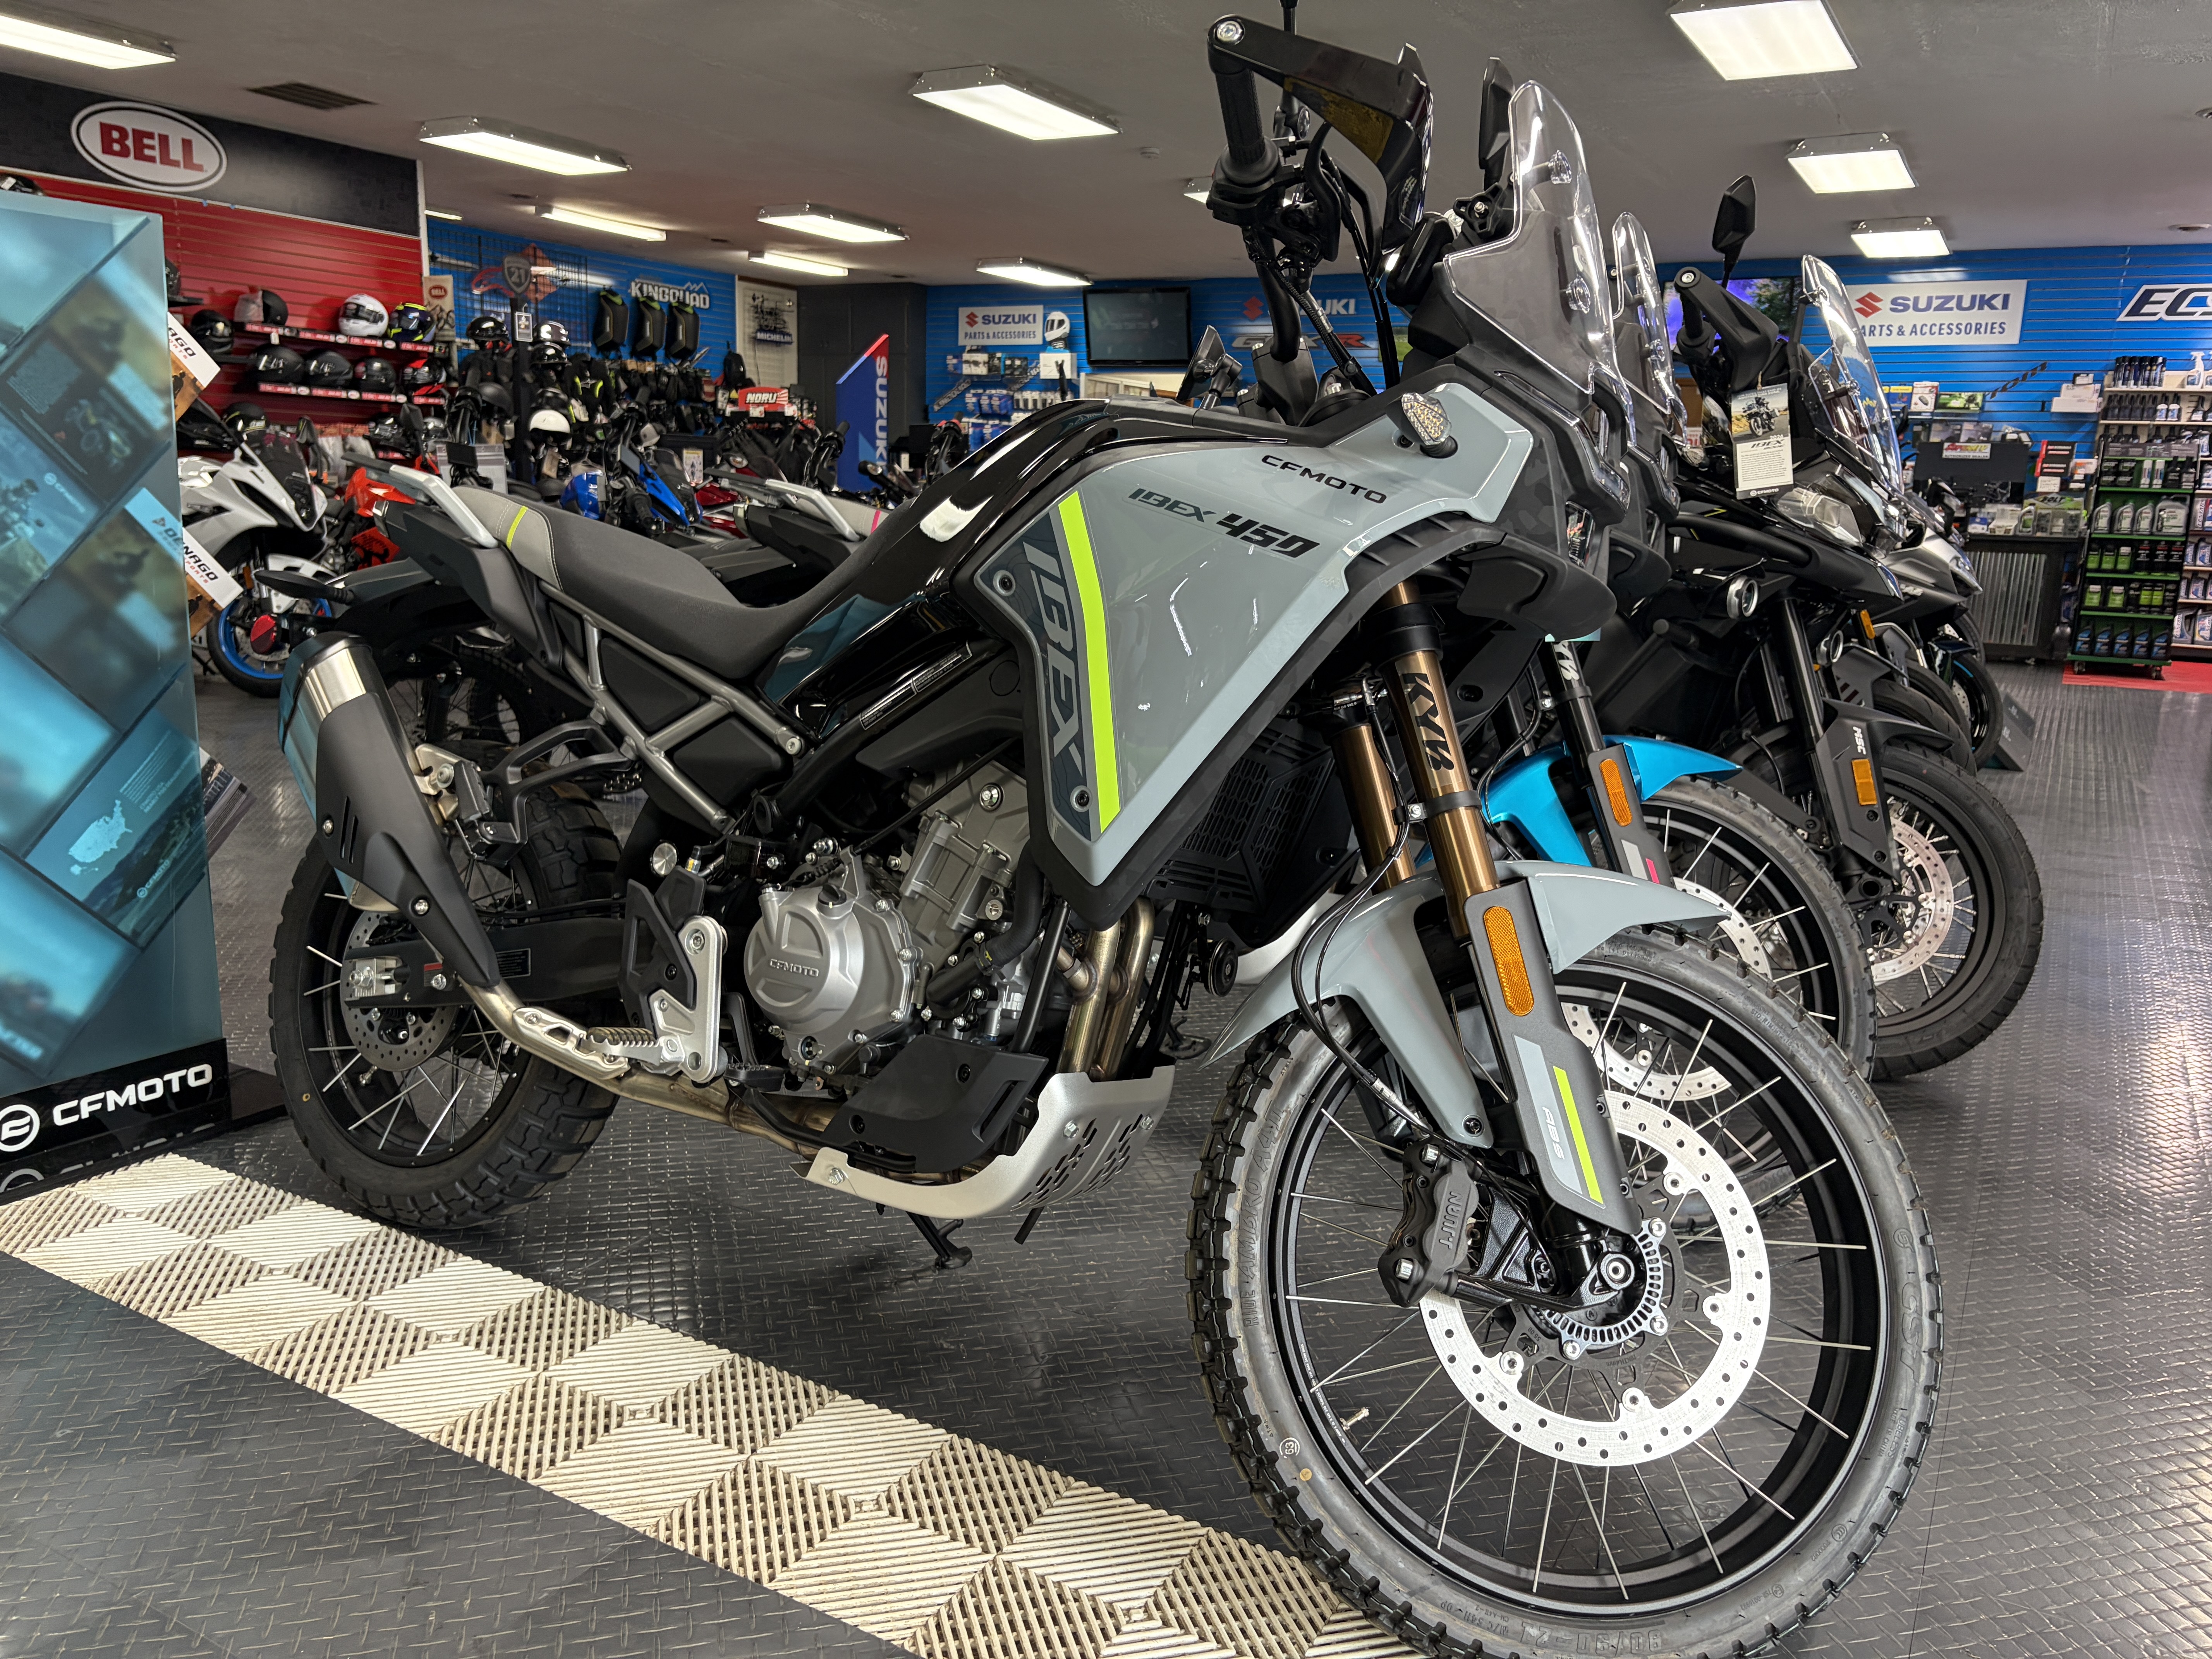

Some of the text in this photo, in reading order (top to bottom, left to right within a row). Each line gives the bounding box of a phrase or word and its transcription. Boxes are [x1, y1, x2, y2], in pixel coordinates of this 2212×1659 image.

[100, 122, 204, 172] BELL
[511, 268, 526, 283] 21
[982, 313, 1037, 325] SUZUKI
[1889, 293, 2011, 313] SUZUKI
[2124, 287, 2212, 317] EC
[757, 332, 792, 342] MICHELIN
[964, 331, 985, 340] PARTS
[992, 331, 1037, 339] ACCESSORIES
[1860, 321, 2006, 337] ARTS & ACCESSORIES
[746, 393, 777, 403] NORU
[875, 356, 888, 465] SUZUKI
[1261, 455, 1387, 504] CFMOTO
[1128, 488, 1320, 558] IBEX 450
[1022, 542, 1084, 777] IBEX
[1402, 673, 1455, 770] KYB
[1852, 726, 1868, 755] MSC
[769, 957, 819, 978] CFMOTO
[53, 1063, 213, 1126] CFMOTO
[1542, 1106, 1565, 1160] ABS
[1237, 1177, 1262, 1280] AMBRO
[1438, 1191, 1462, 1250] J.JUAN
[1240, 1289, 1259, 1327] RIDE
[1901, 1282, 1922, 1385] CST
[1520, 1620, 1662, 1655] 90/90-21
